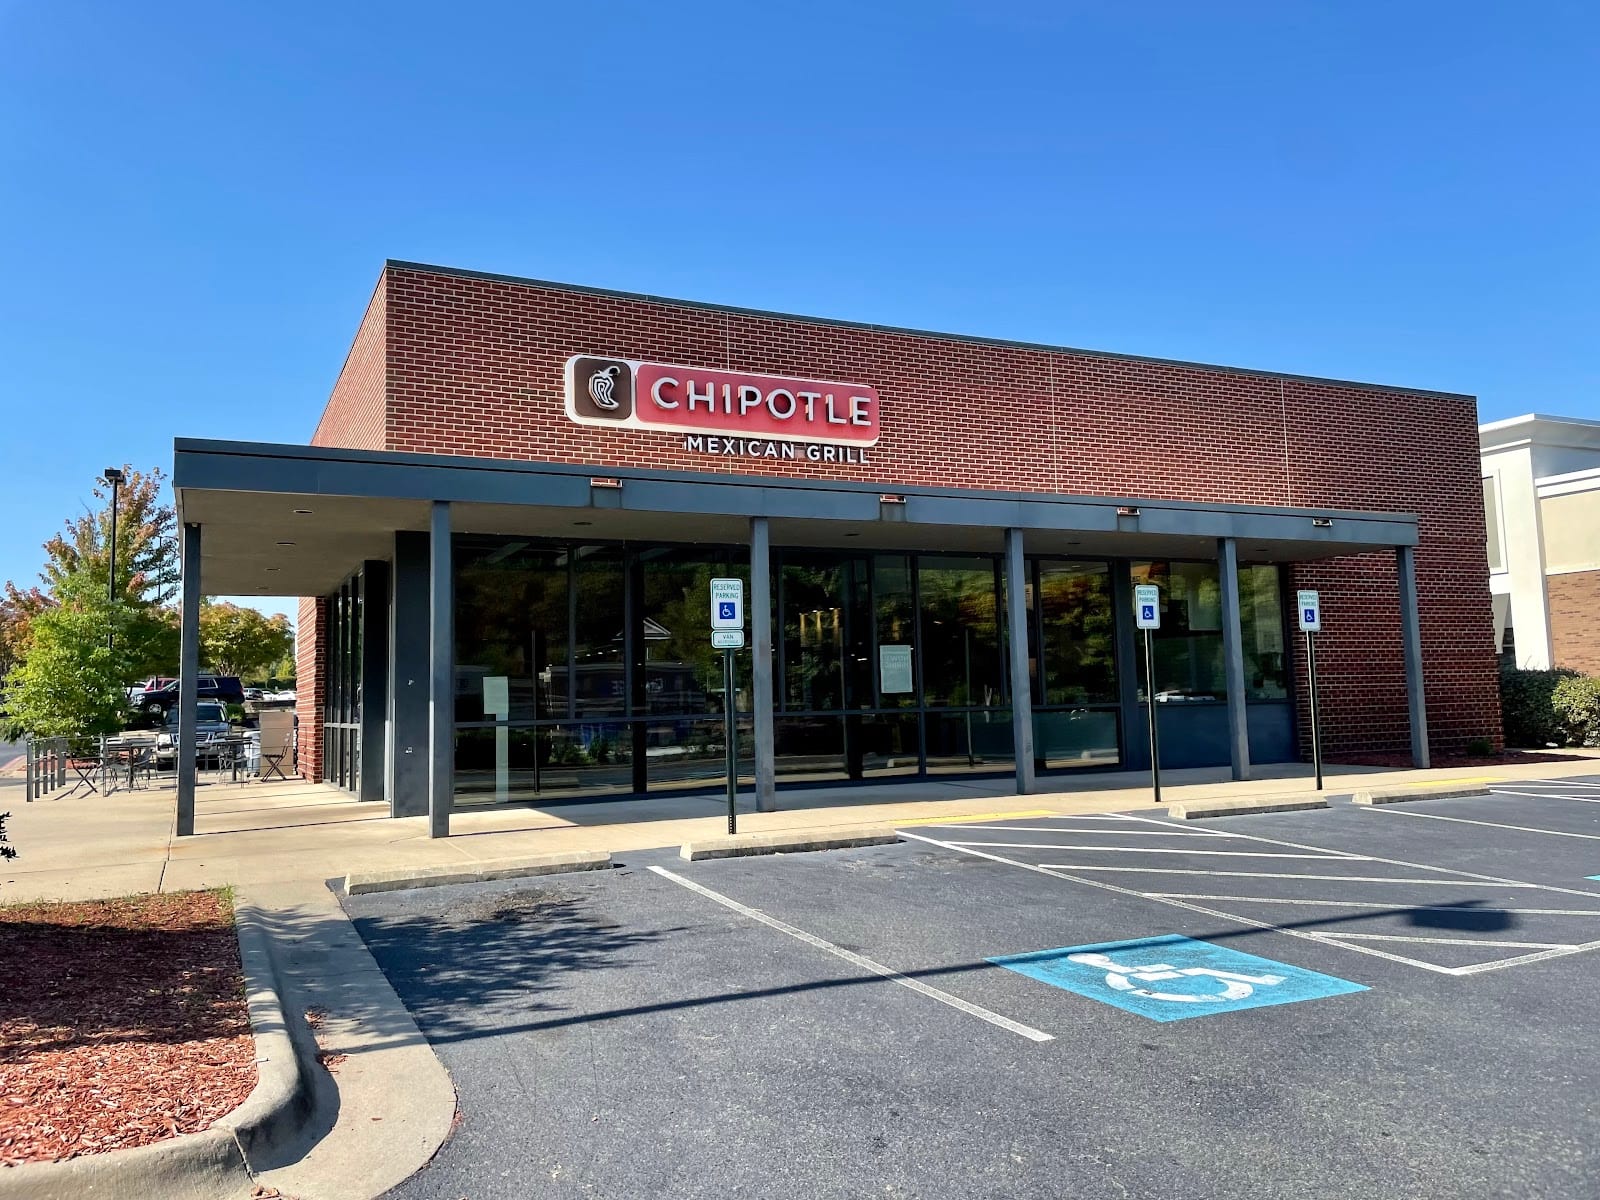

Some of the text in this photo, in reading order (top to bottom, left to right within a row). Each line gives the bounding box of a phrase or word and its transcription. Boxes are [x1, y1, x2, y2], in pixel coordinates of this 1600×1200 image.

[651, 377, 871, 426] CHIPOTLE
[685, 436, 870, 464] MEXICAN GRILL
[713, 583, 740, 591] RESERVED
